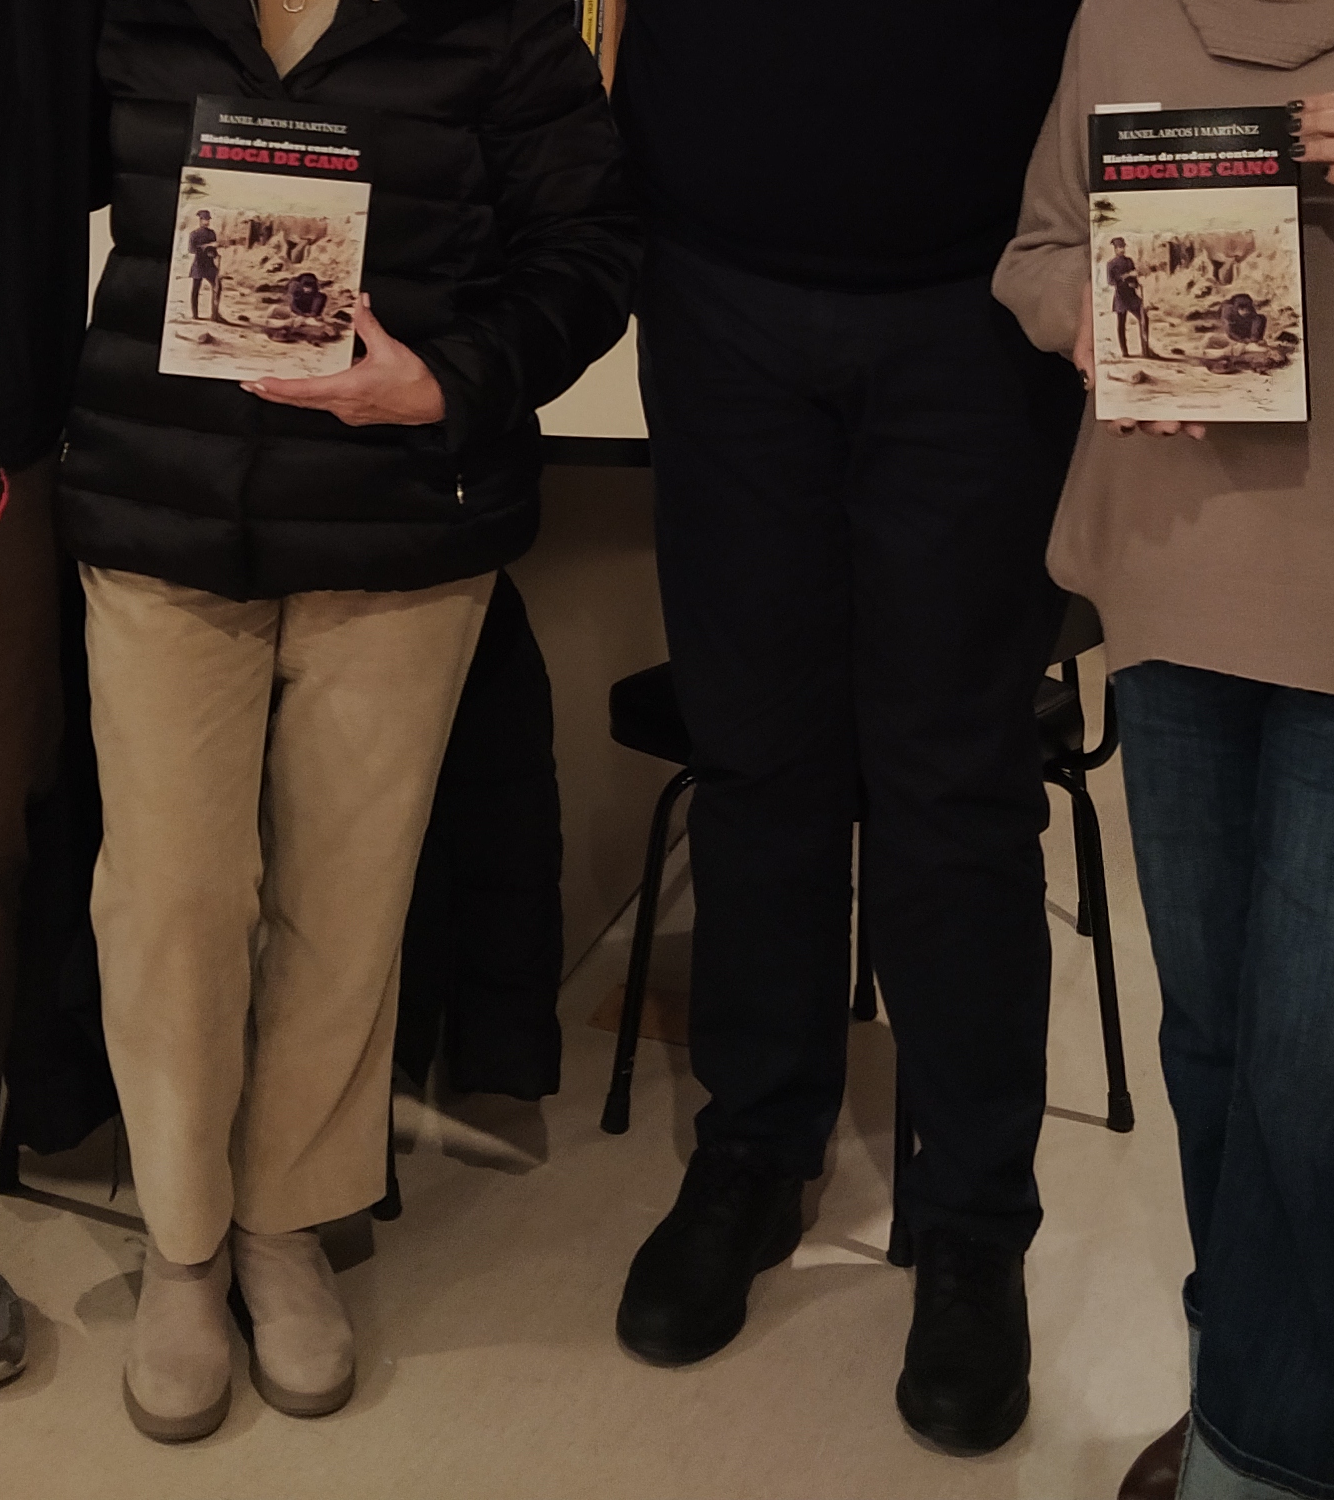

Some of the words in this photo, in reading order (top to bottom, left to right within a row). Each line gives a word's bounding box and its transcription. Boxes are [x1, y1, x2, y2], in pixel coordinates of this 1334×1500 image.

[219, 114, 255, 125] MANEL
[256, 117, 287, 128] ARCOS
[295, 120, 347, 134] MARTÍNEZ
[1118, 129, 1158, 140] MANEL
[1159, 128, 1193, 138] ARCOS
[1200, 124, 1260, 136] MARTÍNEZ
[199, 145, 213, 158] A
[216, 146, 270, 163] BOCA
[274, 151, 300, 166] DE
[304, 154, 359, 171] CANÓ
[1104, 166, 1117, 180] A
[1120, 163, 1179, 180] BOCA
[1182, 162, 1212, 178] DE
[1216, 157, 1279, 176] CANÓ
